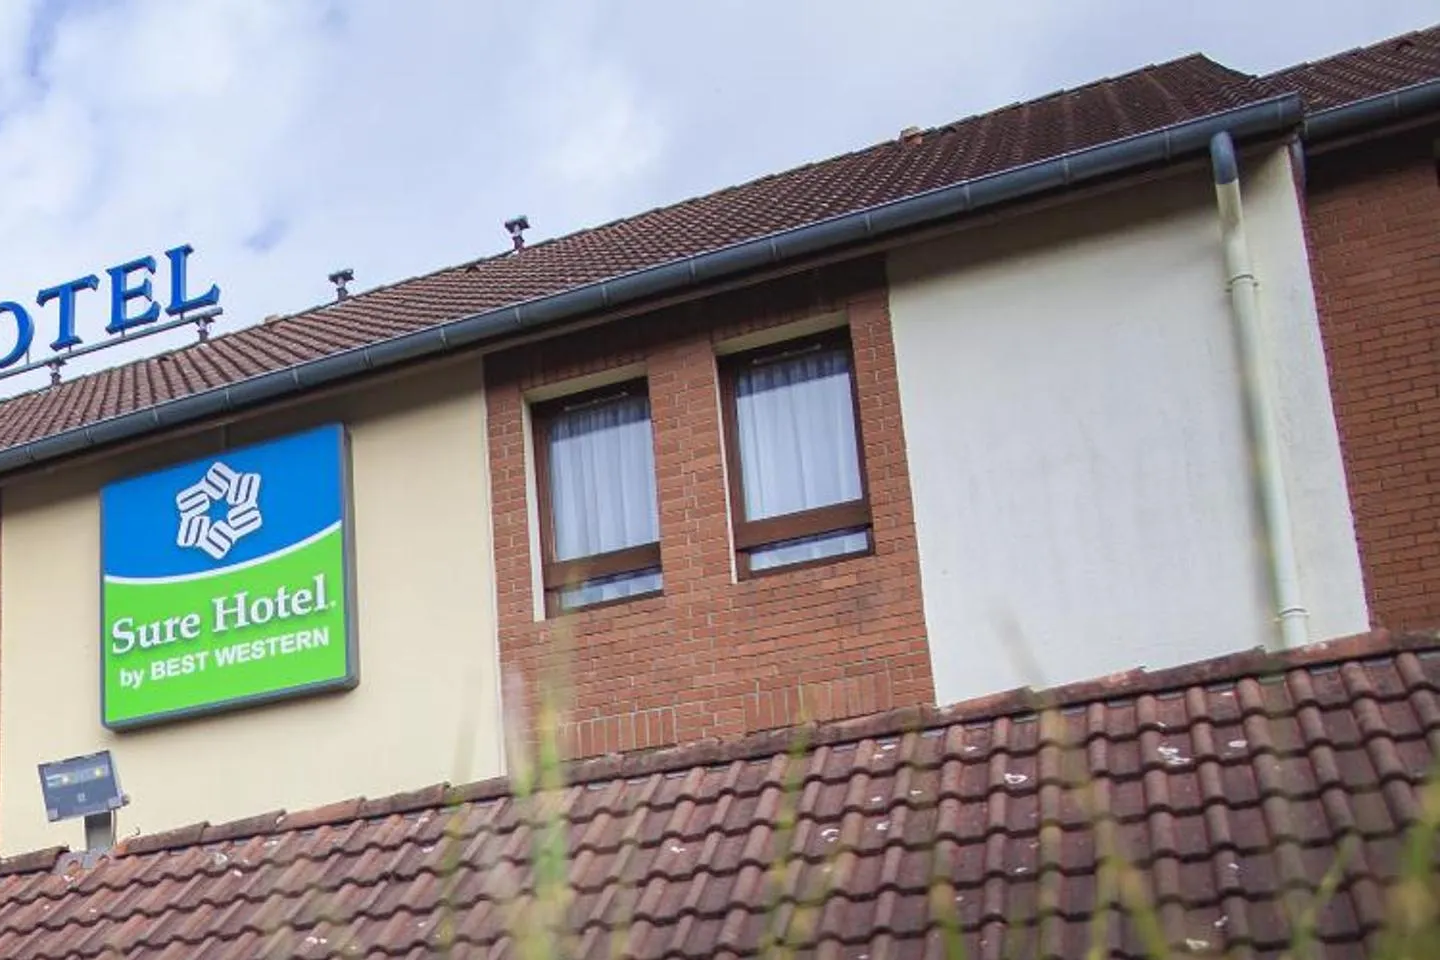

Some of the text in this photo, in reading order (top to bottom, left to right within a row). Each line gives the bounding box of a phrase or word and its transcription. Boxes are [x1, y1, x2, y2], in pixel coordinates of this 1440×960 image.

[112, 612, 201, 654] Sure
[120, 626, 330, 689] by BEST WESTERN
